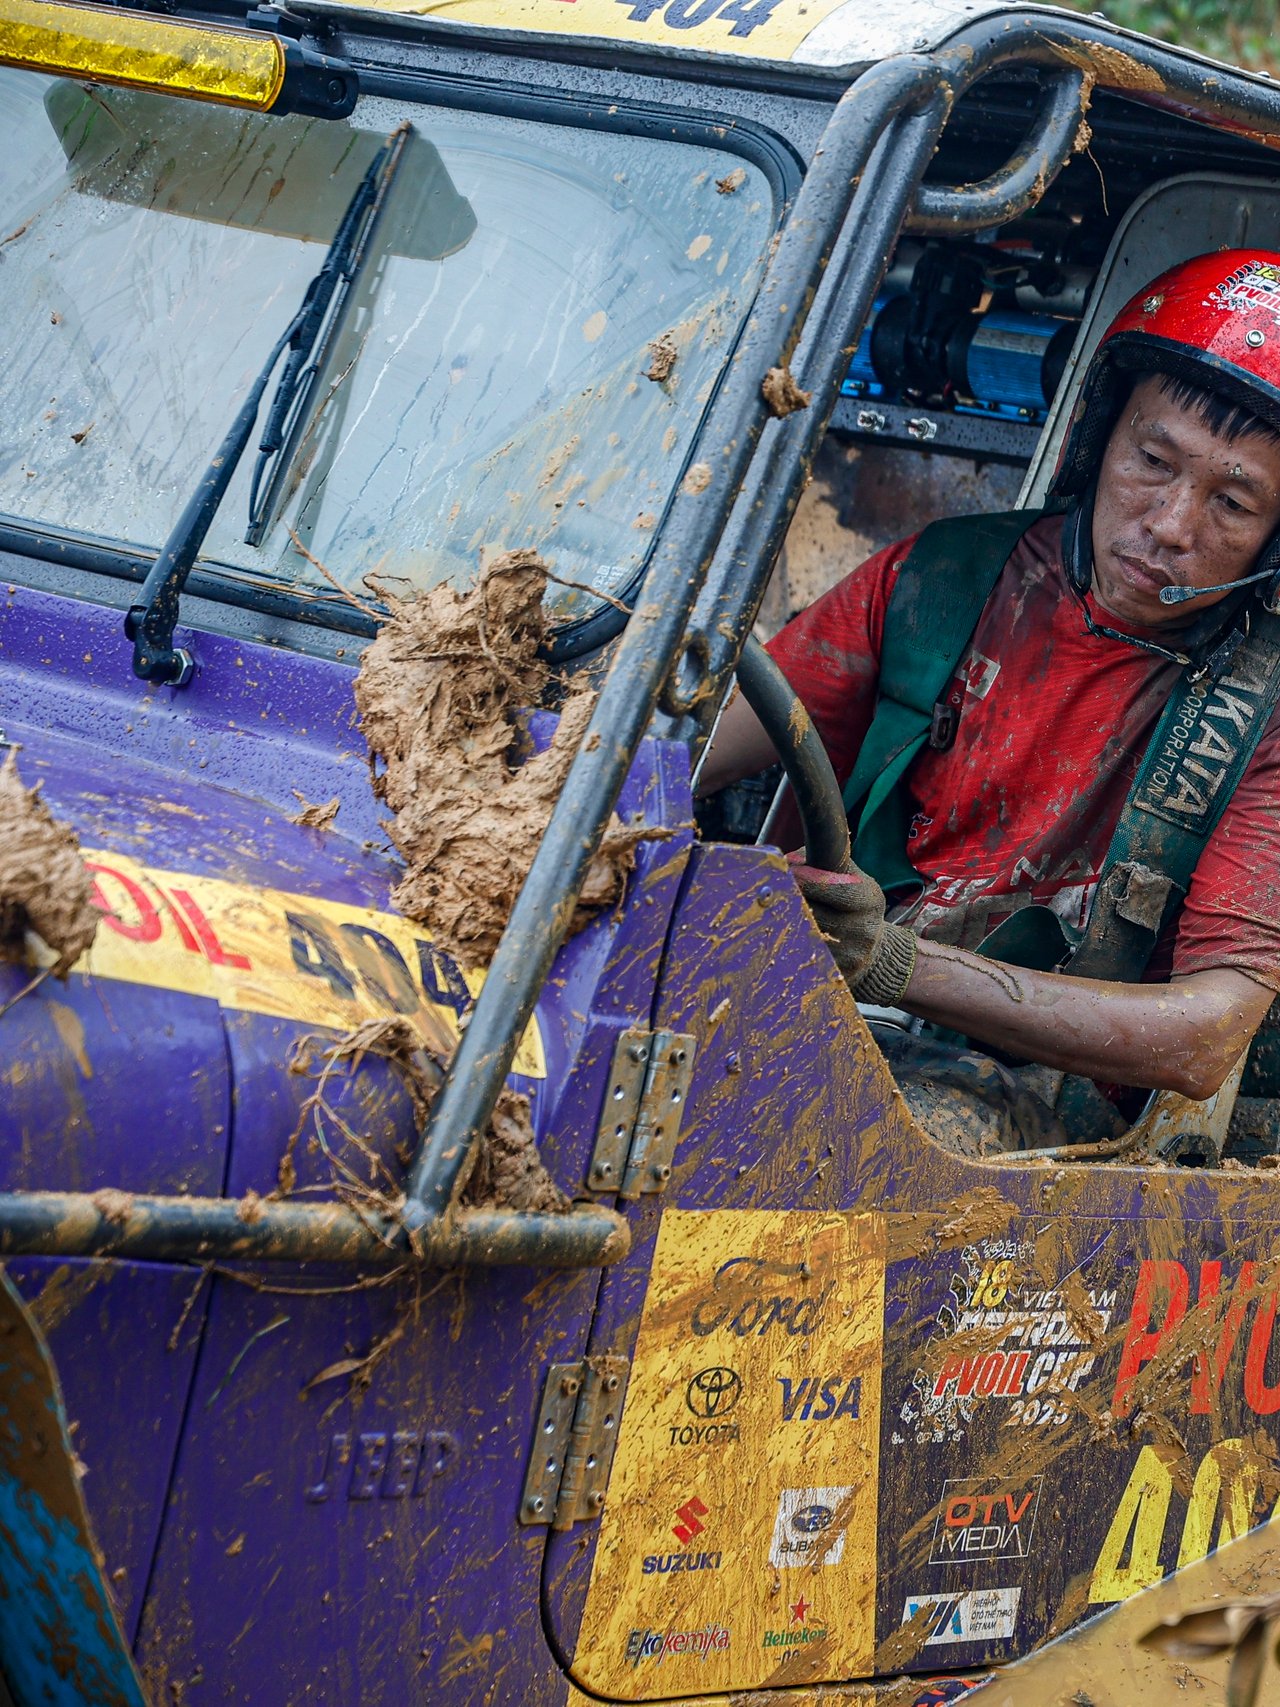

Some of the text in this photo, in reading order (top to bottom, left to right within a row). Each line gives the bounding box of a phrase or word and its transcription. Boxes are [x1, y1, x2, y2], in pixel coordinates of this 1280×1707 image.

[1147, 684, 1208, 801] CORPORATION
[970, 1259, 1015, 1308] 18
[1023, 1289, 1118, 1309] VIETAM
[931, 1350, 1032, 1398] PVOIL
[776, 1375, 863, 1422] VISA
[669, 1424, 742, 1447] TOYOTA
[303, 1431, 461, 1504] JEEP
[944, 1491, 1036, 1527] OTV
[939, 1524, 1024, 1557] MEDIA
[641, 1551, 723, 1575] SUZUKI
[625, 1621, 731, 1669] Ekokemika
[761, 1627, 828, 1648] Heineken
